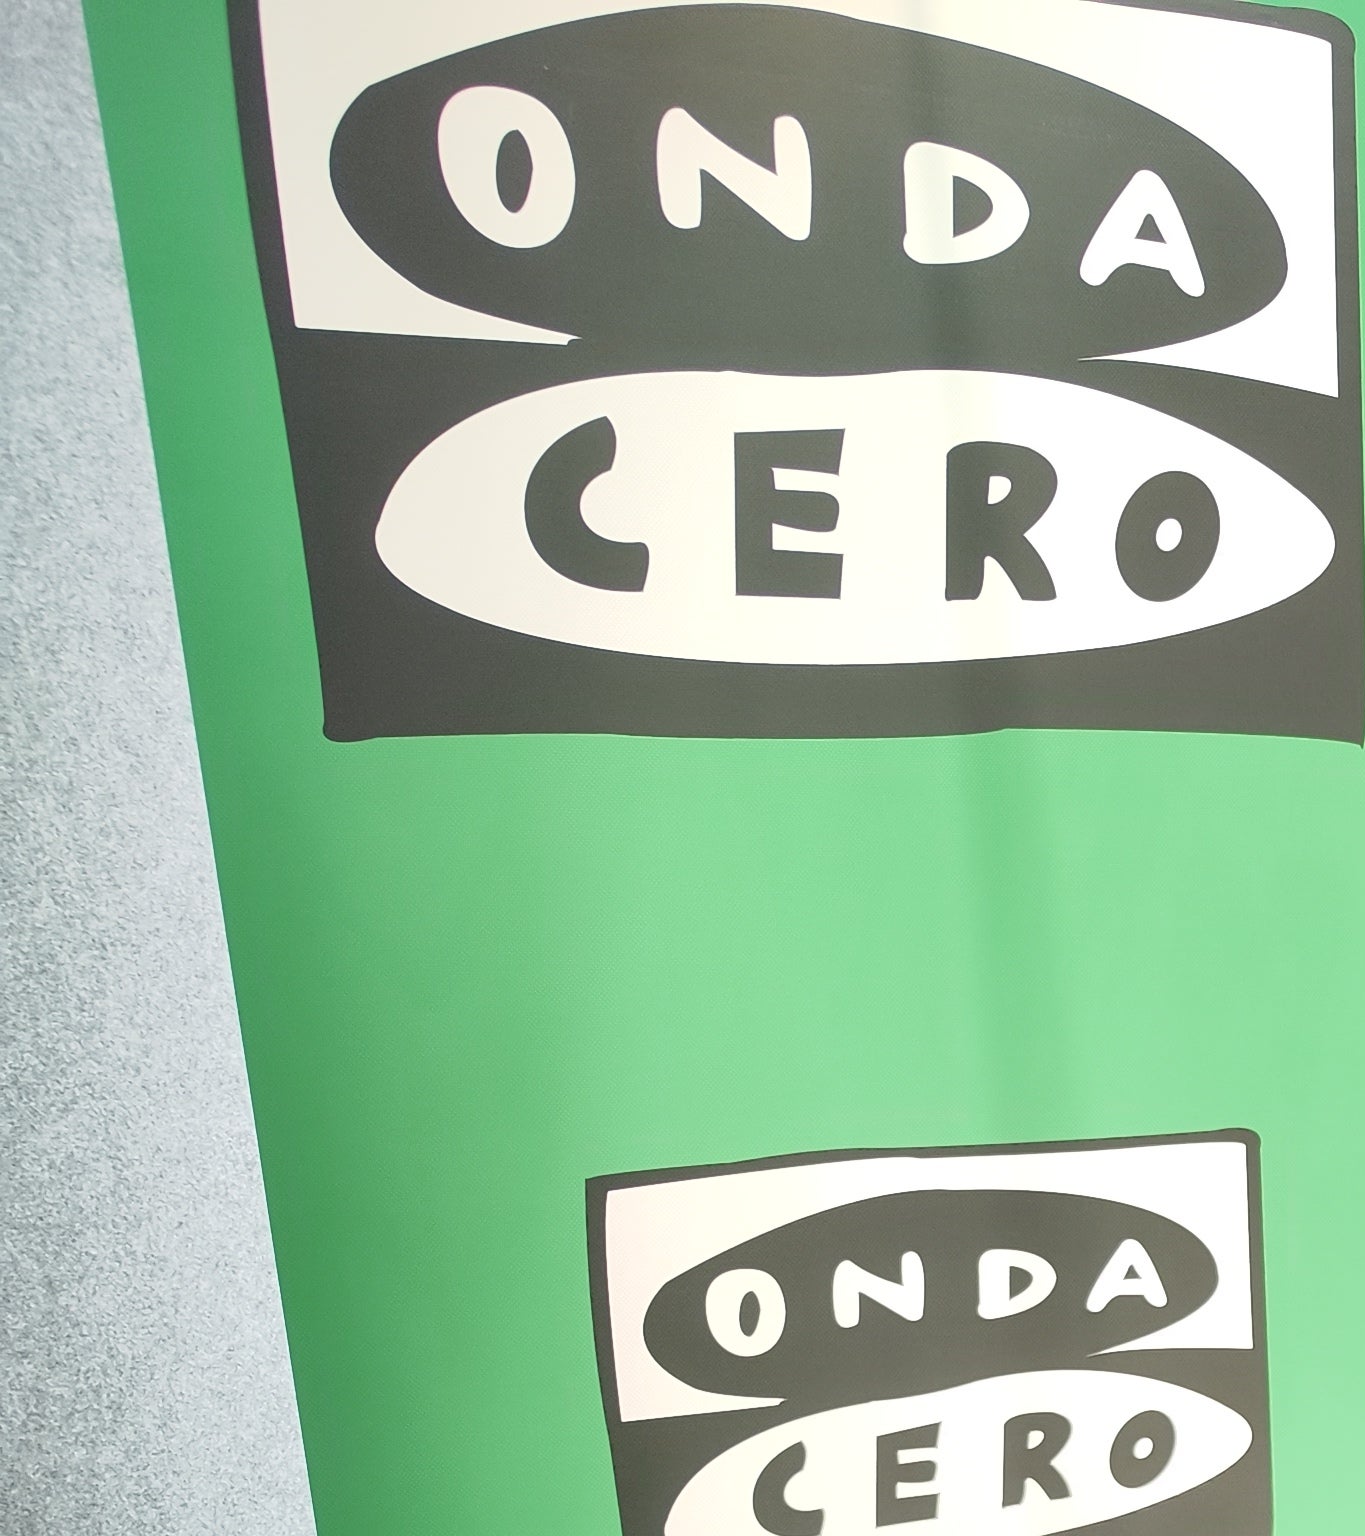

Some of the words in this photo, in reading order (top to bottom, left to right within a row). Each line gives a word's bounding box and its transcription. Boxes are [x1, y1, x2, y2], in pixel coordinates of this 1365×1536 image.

[437, 85, 1206, 298] ONDA
[524, 415, 1222, 604] CERO
[704, 1237, 1169, 1358] ONDA
